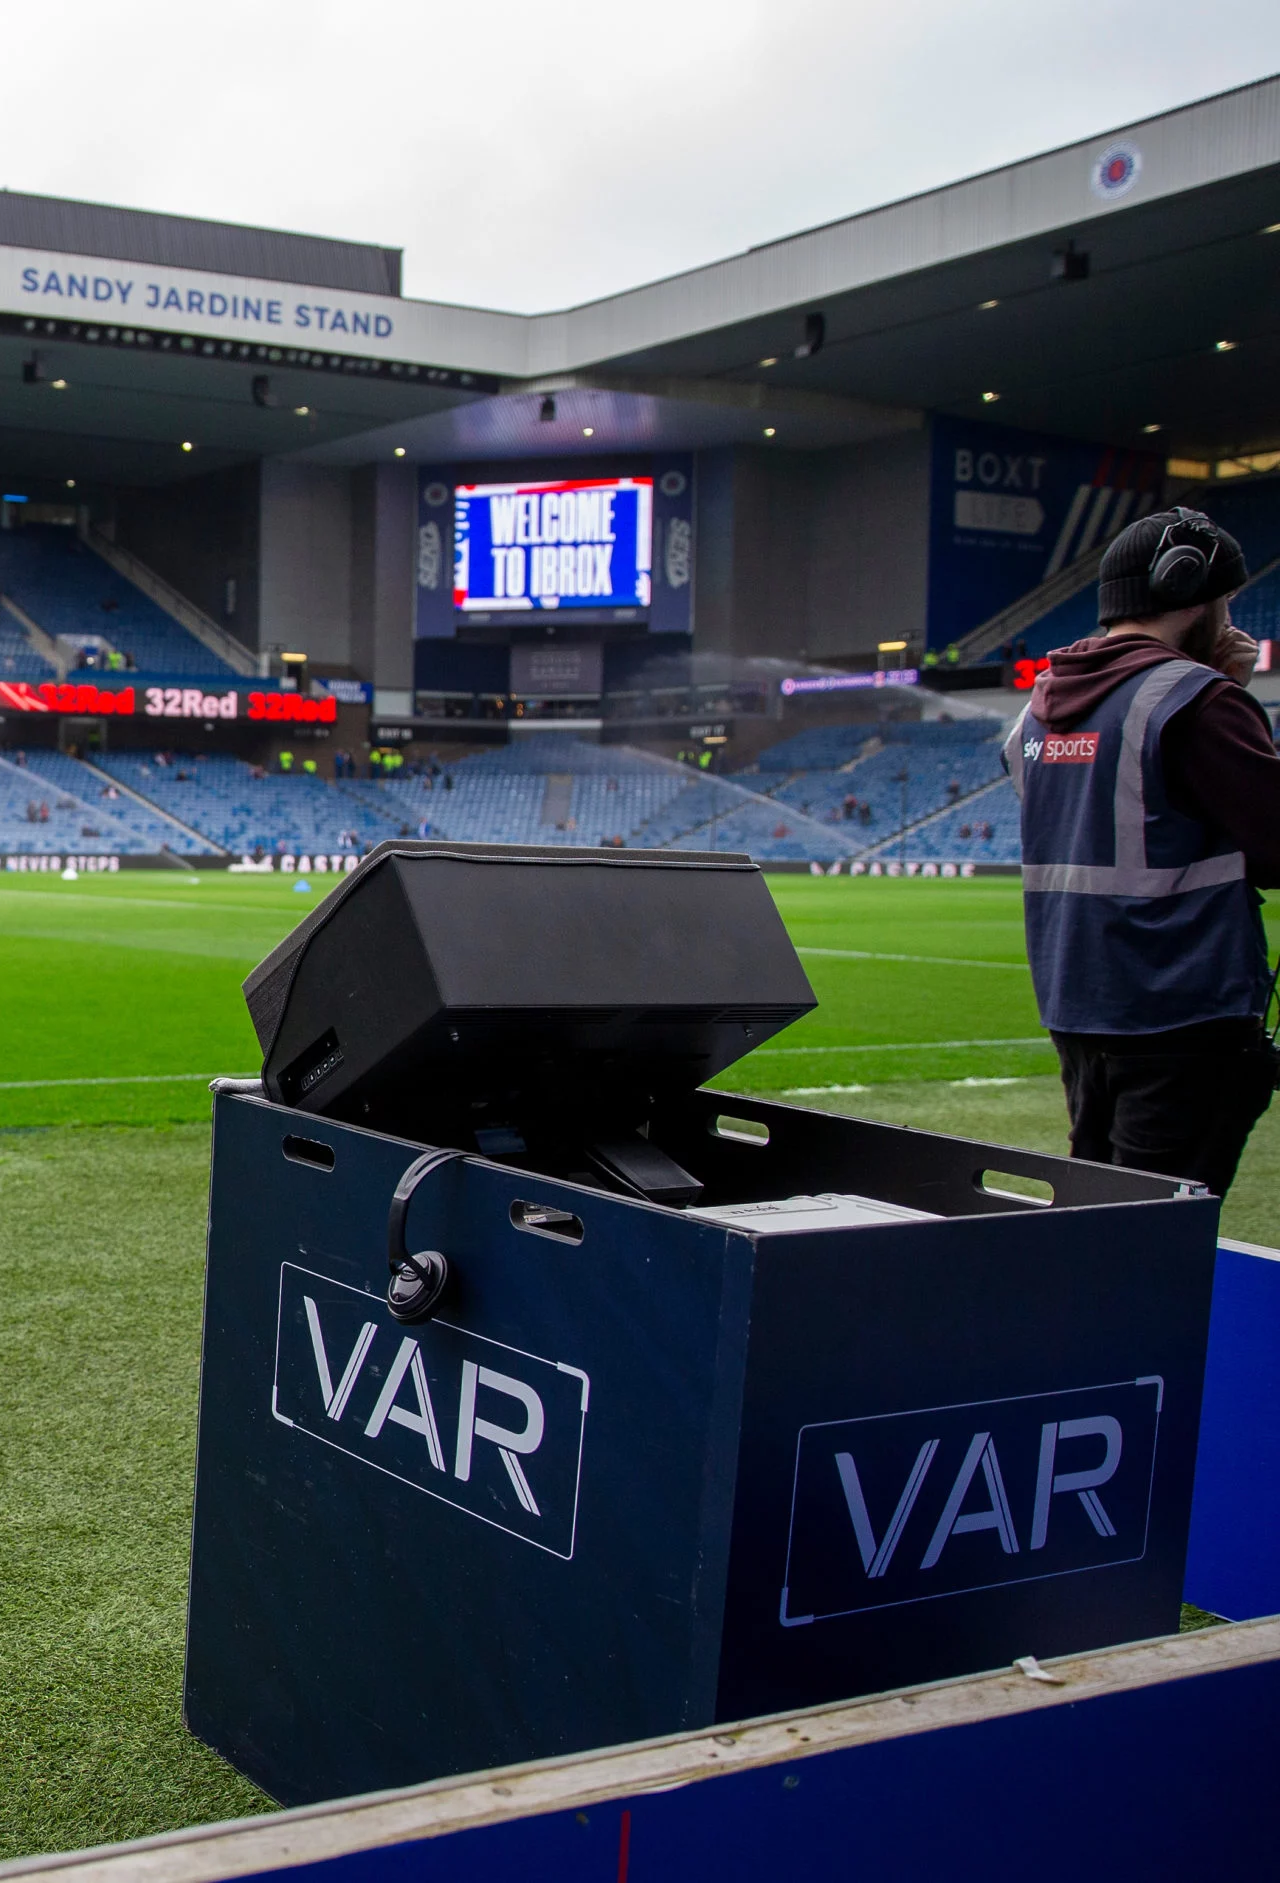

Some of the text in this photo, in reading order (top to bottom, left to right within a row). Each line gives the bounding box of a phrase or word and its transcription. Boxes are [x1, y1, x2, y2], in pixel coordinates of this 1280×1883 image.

[22, 268, 394, 338] SANDY JARDINE STAND
[954, 448, 1047, 490] BOXT
[489, 490, 617, 547] WELCOME
[491, 543, 613, 598] TO IBROX
[38, 682, 136, 715] 32Red
[144, 686, 239, 720] 32Red
[247, 691, 338, 723] 32Red
[1023, 737, 1095, 761] sky sports
[7, 855, 61, 872] NEVER
[303, 1295, 545, 1517] VAR
[834, 1415, 1123, 1579] VAR
